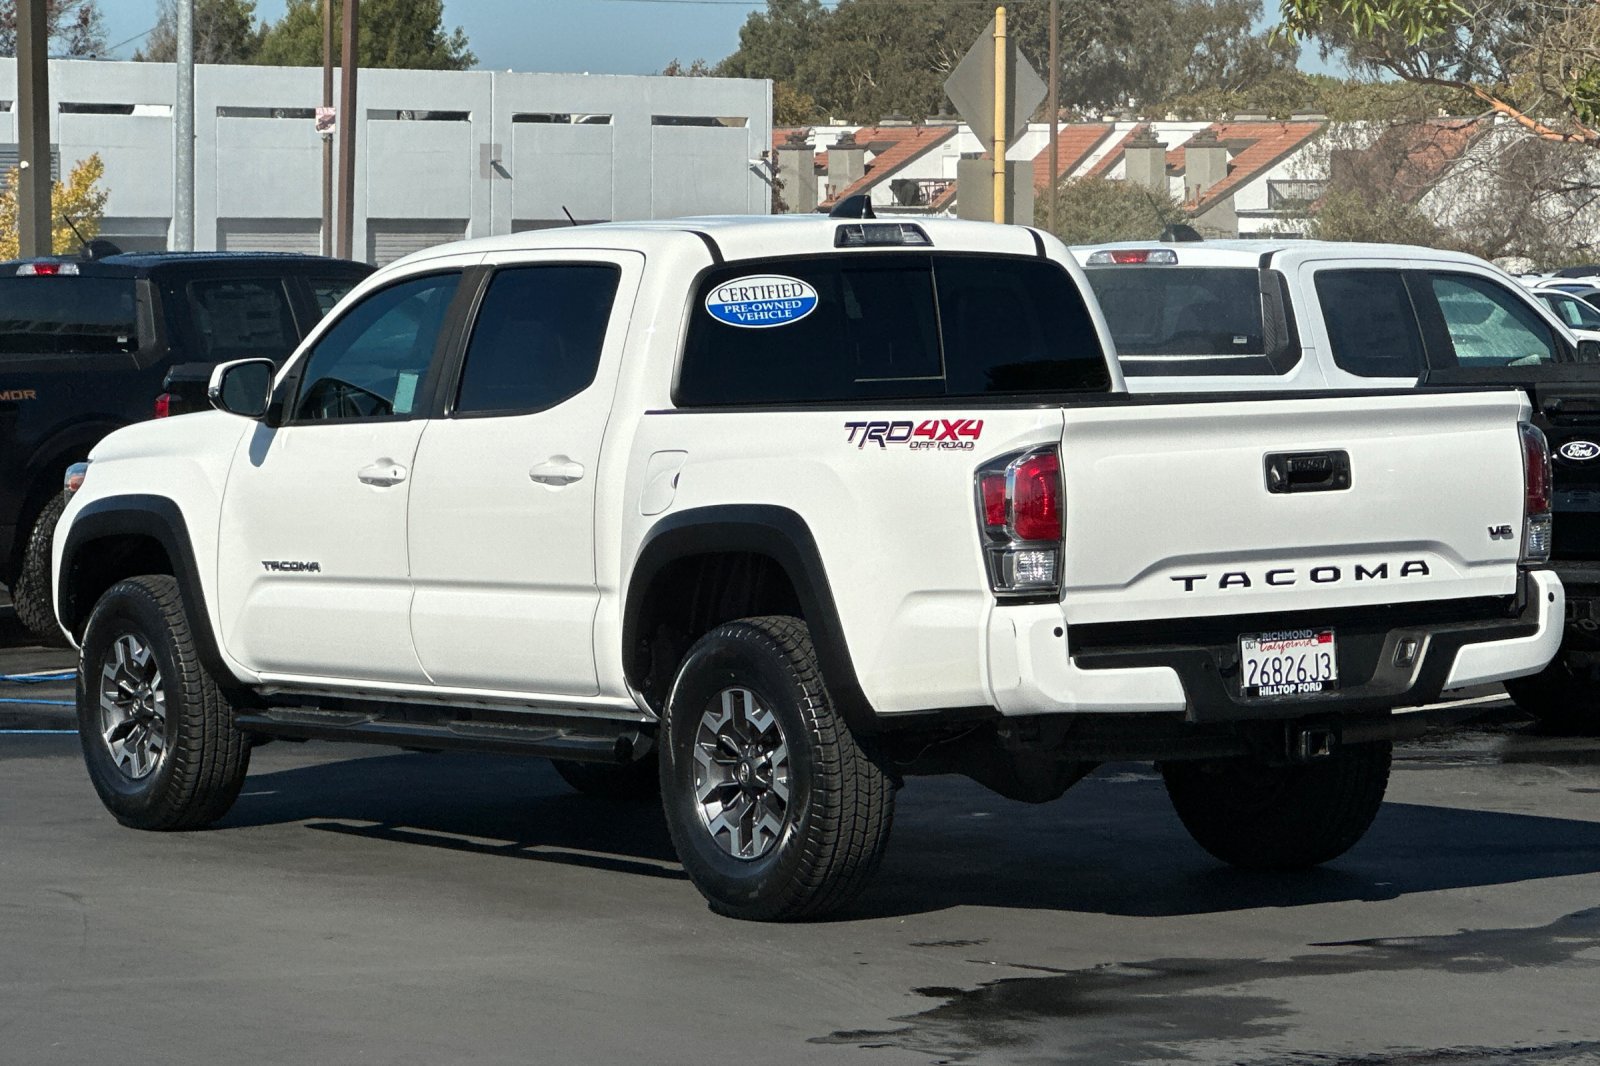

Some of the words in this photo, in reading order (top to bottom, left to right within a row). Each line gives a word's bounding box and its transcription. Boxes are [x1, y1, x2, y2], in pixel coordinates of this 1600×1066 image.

[717, 282, 804, 303] CERTIFIED
[724, 300, 802, 314] PRE-OWNED
[737, 309, 793, 321] VEHICLE
[909, 441, 936, 450] OFF
[937, 441, 975, 451] ROAD
[1567, 443, 1593, 457] Ford
[1488, 525, 1513, 539] V6
[261, 561, 321, 572] TACOMA
[1169, 560, 1430, 592] TACOMA
[1262, 629, 1313, 641] RICHMOND
[1245, 641, 1256, 650] OCT
[1259, 639, 1318, 654] California
[1247, 652, 1332, 687] 26826J3
[1259, 683, 1297, 696] HILLTOP
[1298, 682, 1323, 693] FORD
